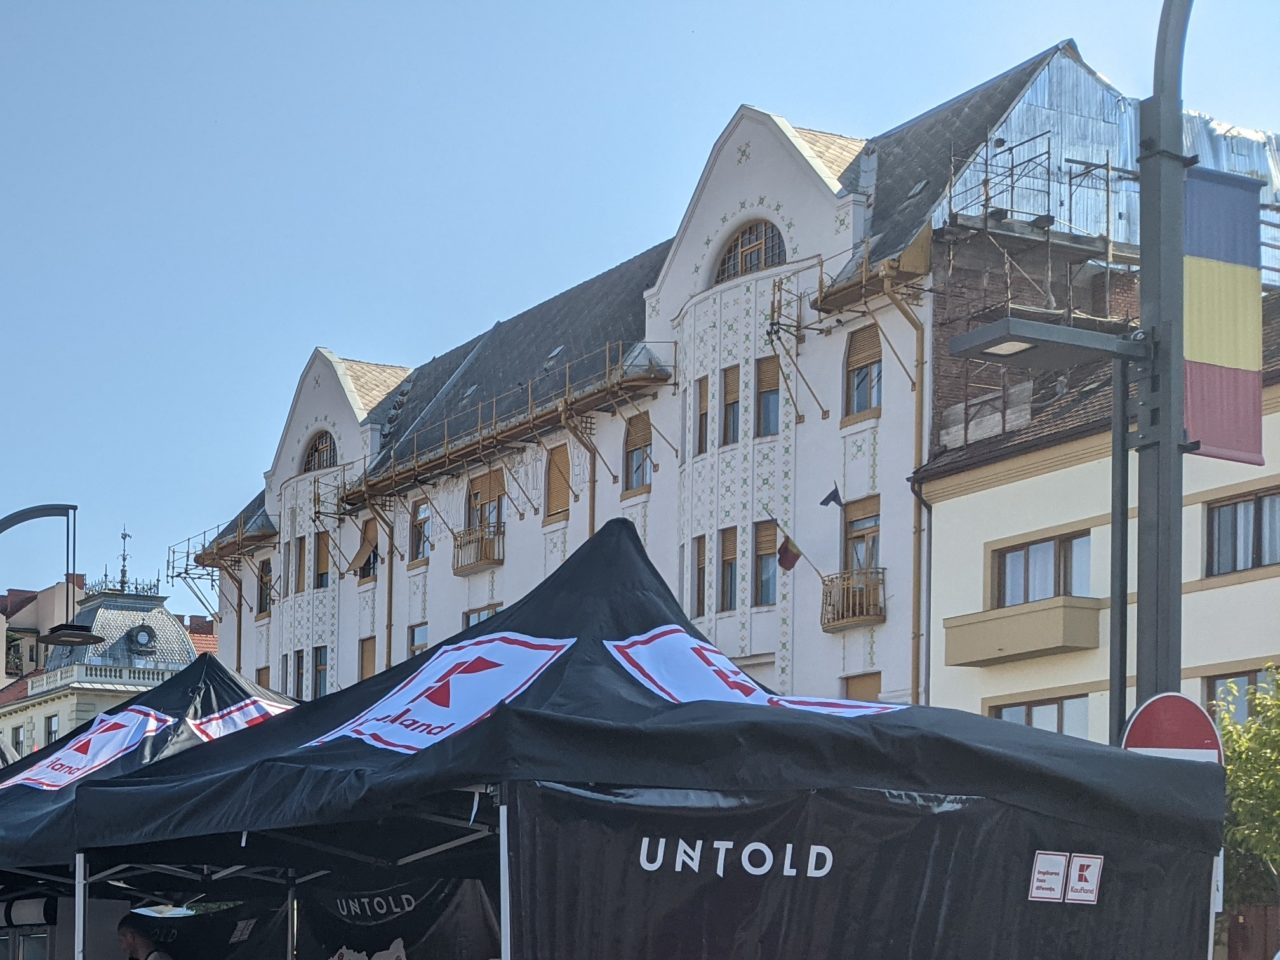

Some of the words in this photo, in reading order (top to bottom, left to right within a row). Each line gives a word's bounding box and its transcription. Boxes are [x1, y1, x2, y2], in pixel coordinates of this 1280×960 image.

[639, 837, 833, 878] UNTOLD
[1070, 885, 1095, 895] Kaufland
[336, 894, 416, 917] UNTOLD
